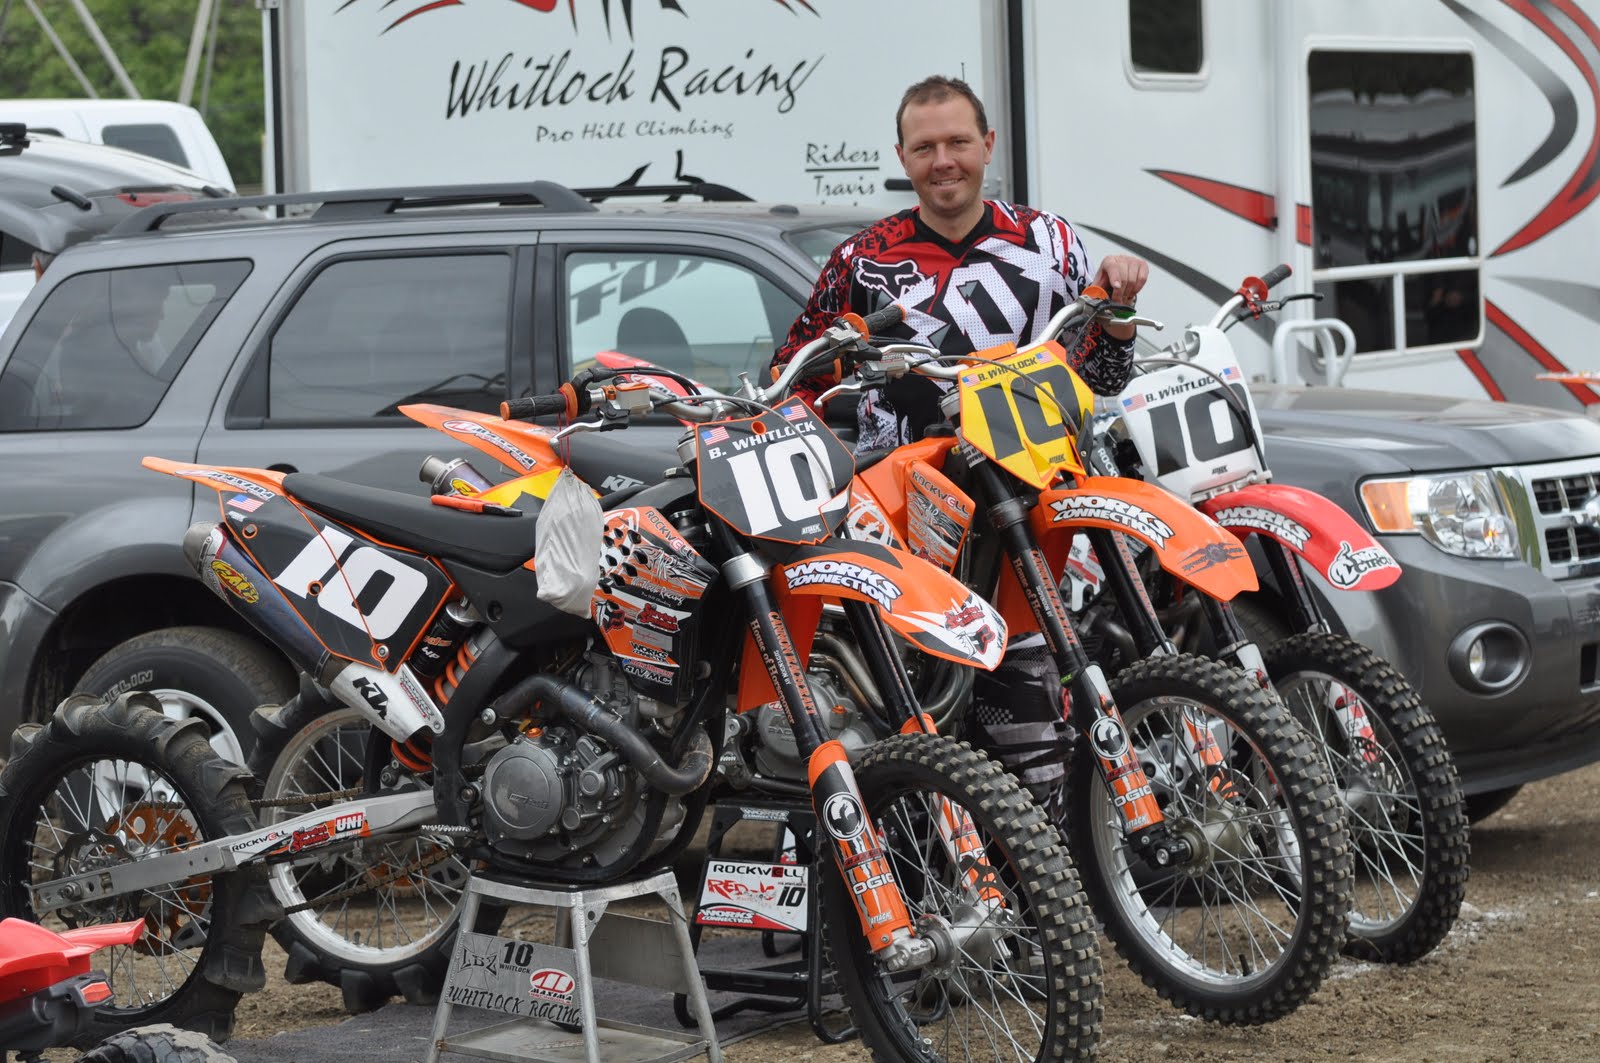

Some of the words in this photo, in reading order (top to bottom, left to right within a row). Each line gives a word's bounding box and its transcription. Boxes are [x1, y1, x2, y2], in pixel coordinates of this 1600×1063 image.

[445, 47, 636, 119] Whitlock
[650, 46, 825, 113] Racing
[536, 125, 574, 142] Pro
[582, 121, 626, 139] Hill
[634, 119, 734, 138] Climbing
[806, 142, 880, 166] Riders
[814, 175, 875, 196] Travis
[978, 374, 988, 382] B.
[974, 364, 1083, 461] 10
[1145, 393, 1157, 403] B.
[708, 446, 727, 460] B.
[732, 420, 816, 451] WHITLOCK
[1147, 383, 1254, 478] 10
[726, 433, 848, 536] 10
[912, 471, 970, 516] ROCKWELL
[1049, 495, 1176, 539] WORKS
[1053, 508, 1165, 550] CONNECTION
[1215, 505, 1312, 541] WORKS
[645, 510, 698, 562] ROCKWELL
[272, 525, 428, 640] 10
[784, 560, 903, 600] WORKS
[788, 573, 892, 613] CONNECTION
[750, 618, 766, 651] House
[353, 676, 392, 720] KTM
[231, 829, 288, 852] ROCKWELL
[335, 813, 363, 832] UNI
[713, 864, 804, 878] ROCKWELL
[853, 872, 895, 895] OGIO
[777, 886, 806, 907] 10
[500, 962, 531, 974] WHITLOCK
[503, 941, 534, 967] 10
[449, 985, 524, 1015] WHITLOCK
[528, 1000, 580, 1025] RACING
[530, 988, 573, 1001] MAXIMA
